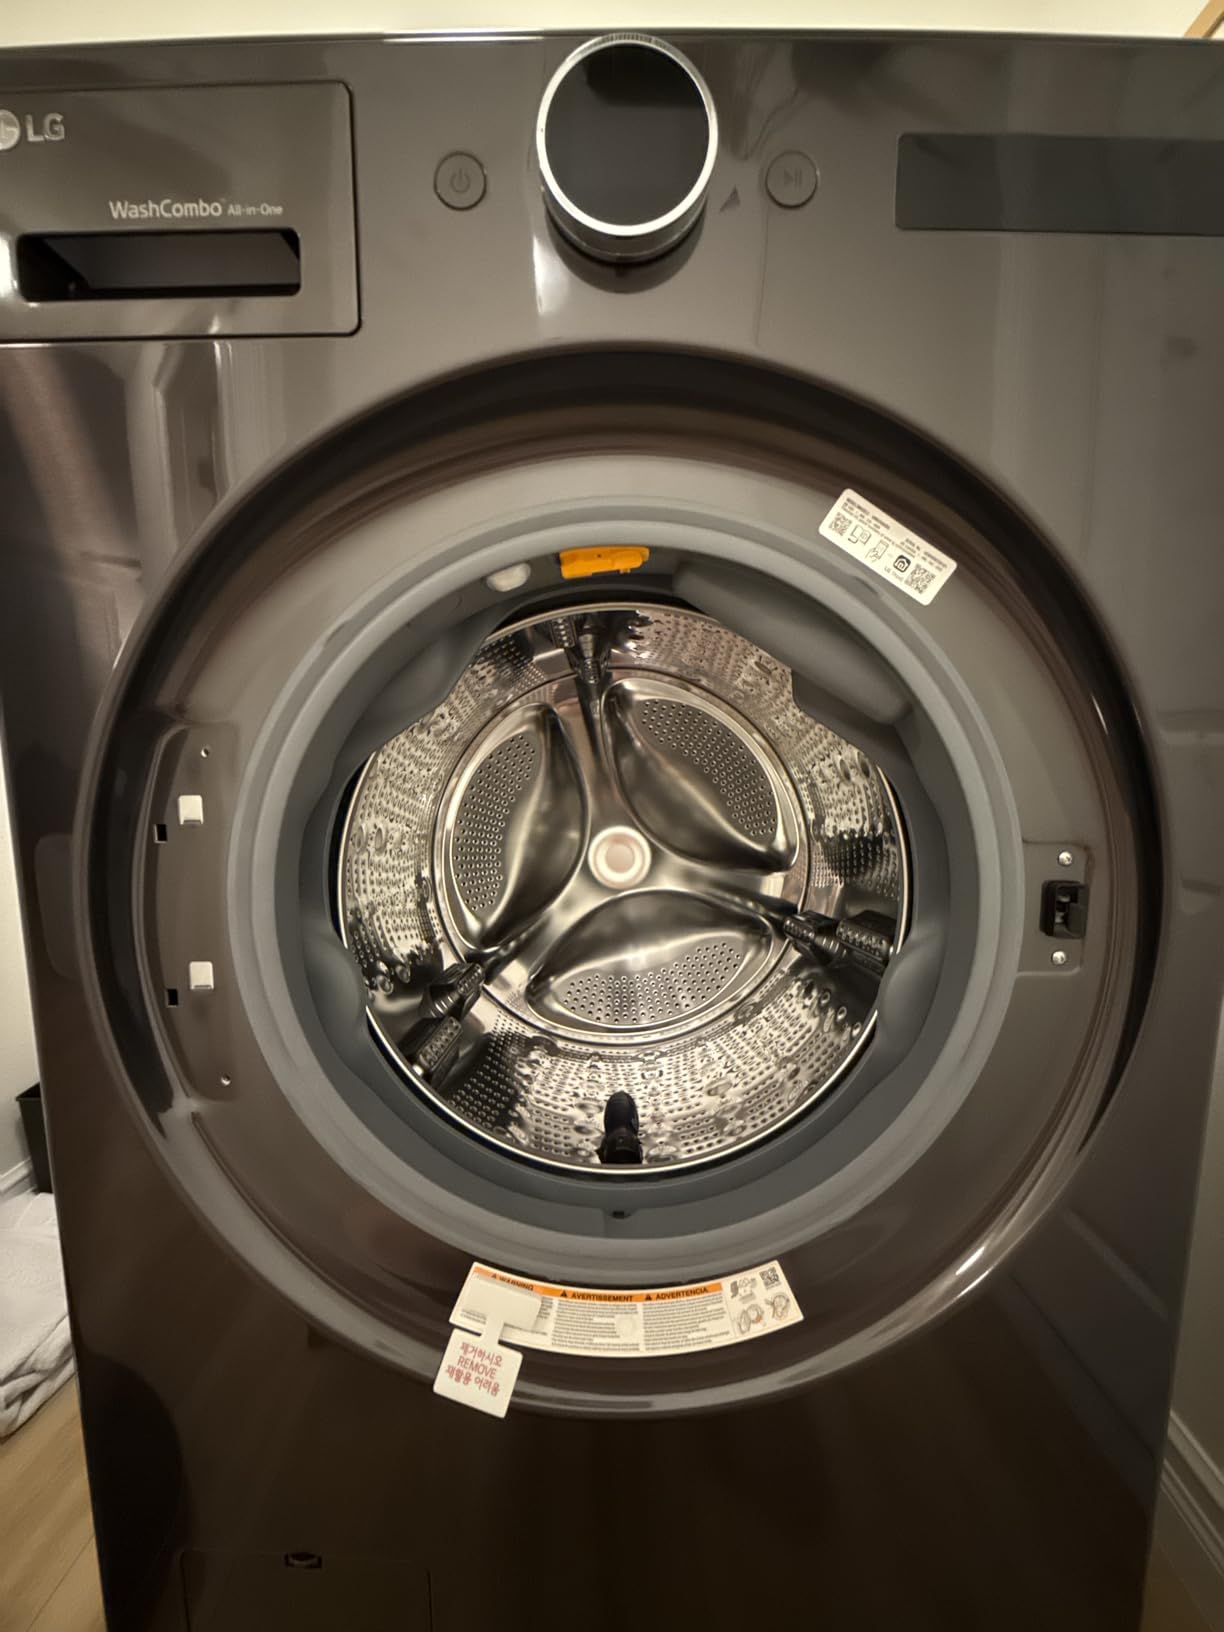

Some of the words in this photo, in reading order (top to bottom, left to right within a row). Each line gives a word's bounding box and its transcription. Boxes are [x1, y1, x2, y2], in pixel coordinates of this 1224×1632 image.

[25, 113, 65, 142] LG
[109, 199, 223, 219] WashCombo
[571, 1291, 634, 1302] AVERTISSEMENT
[656, 1287, 709, 1300] ADVERTENCIA
[457, 1355, 497, 1380] REMOVE
